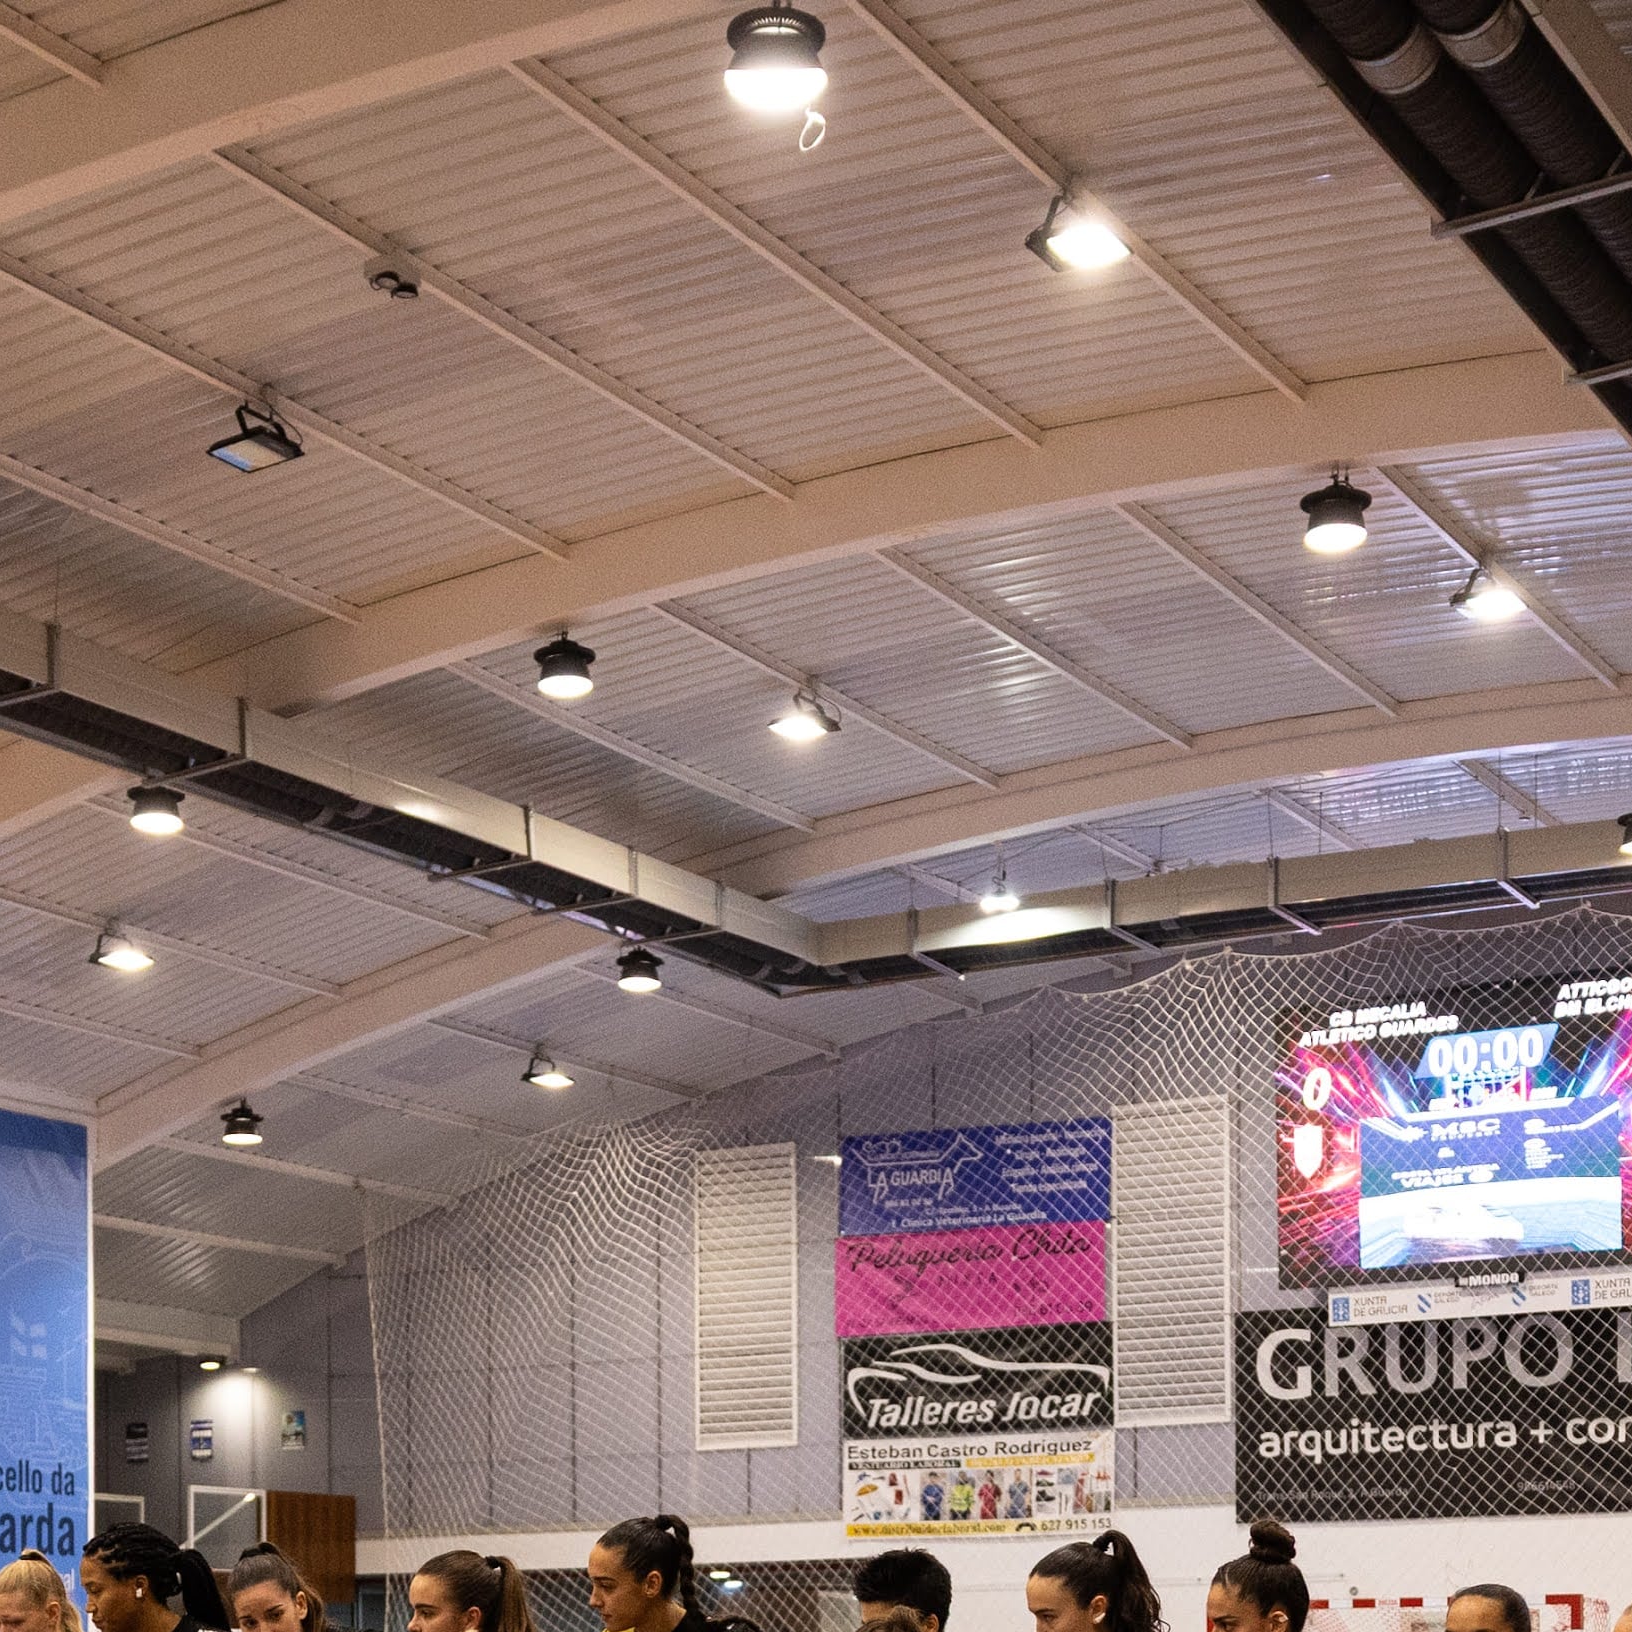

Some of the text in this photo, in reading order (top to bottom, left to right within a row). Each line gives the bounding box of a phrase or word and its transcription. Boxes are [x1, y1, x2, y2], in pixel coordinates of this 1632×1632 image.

[1379, 1015, 1460, 1038] GUARDES
[1427, 1028, 1544, 1077] 00:00
[1302, 1067, 1332, 1112] 0
[1468, 1272, 1520, 1287] MONDO
[1594, 1277, 1631, 1289] XUNTA
[1353, 1295, 1388, 1306] XUNTA
[1594, 1289, 1608, 1300] DE
[1353, 1304, 1409, 1317] DE GALICIA
[1255, 1316, 1574, 1402] GRUPO
[867, 1391, 1103, 1428] Talleres Jocar
[847, 1444, 924, 1460] Esteban
[927, 1442, 988, 1459] Castro
[1258, 1417, 1518, 1465] arquitectura
[52, 1463, 76, 1496] da
[1041, 1517, 1113, 1532] 627 915 153
